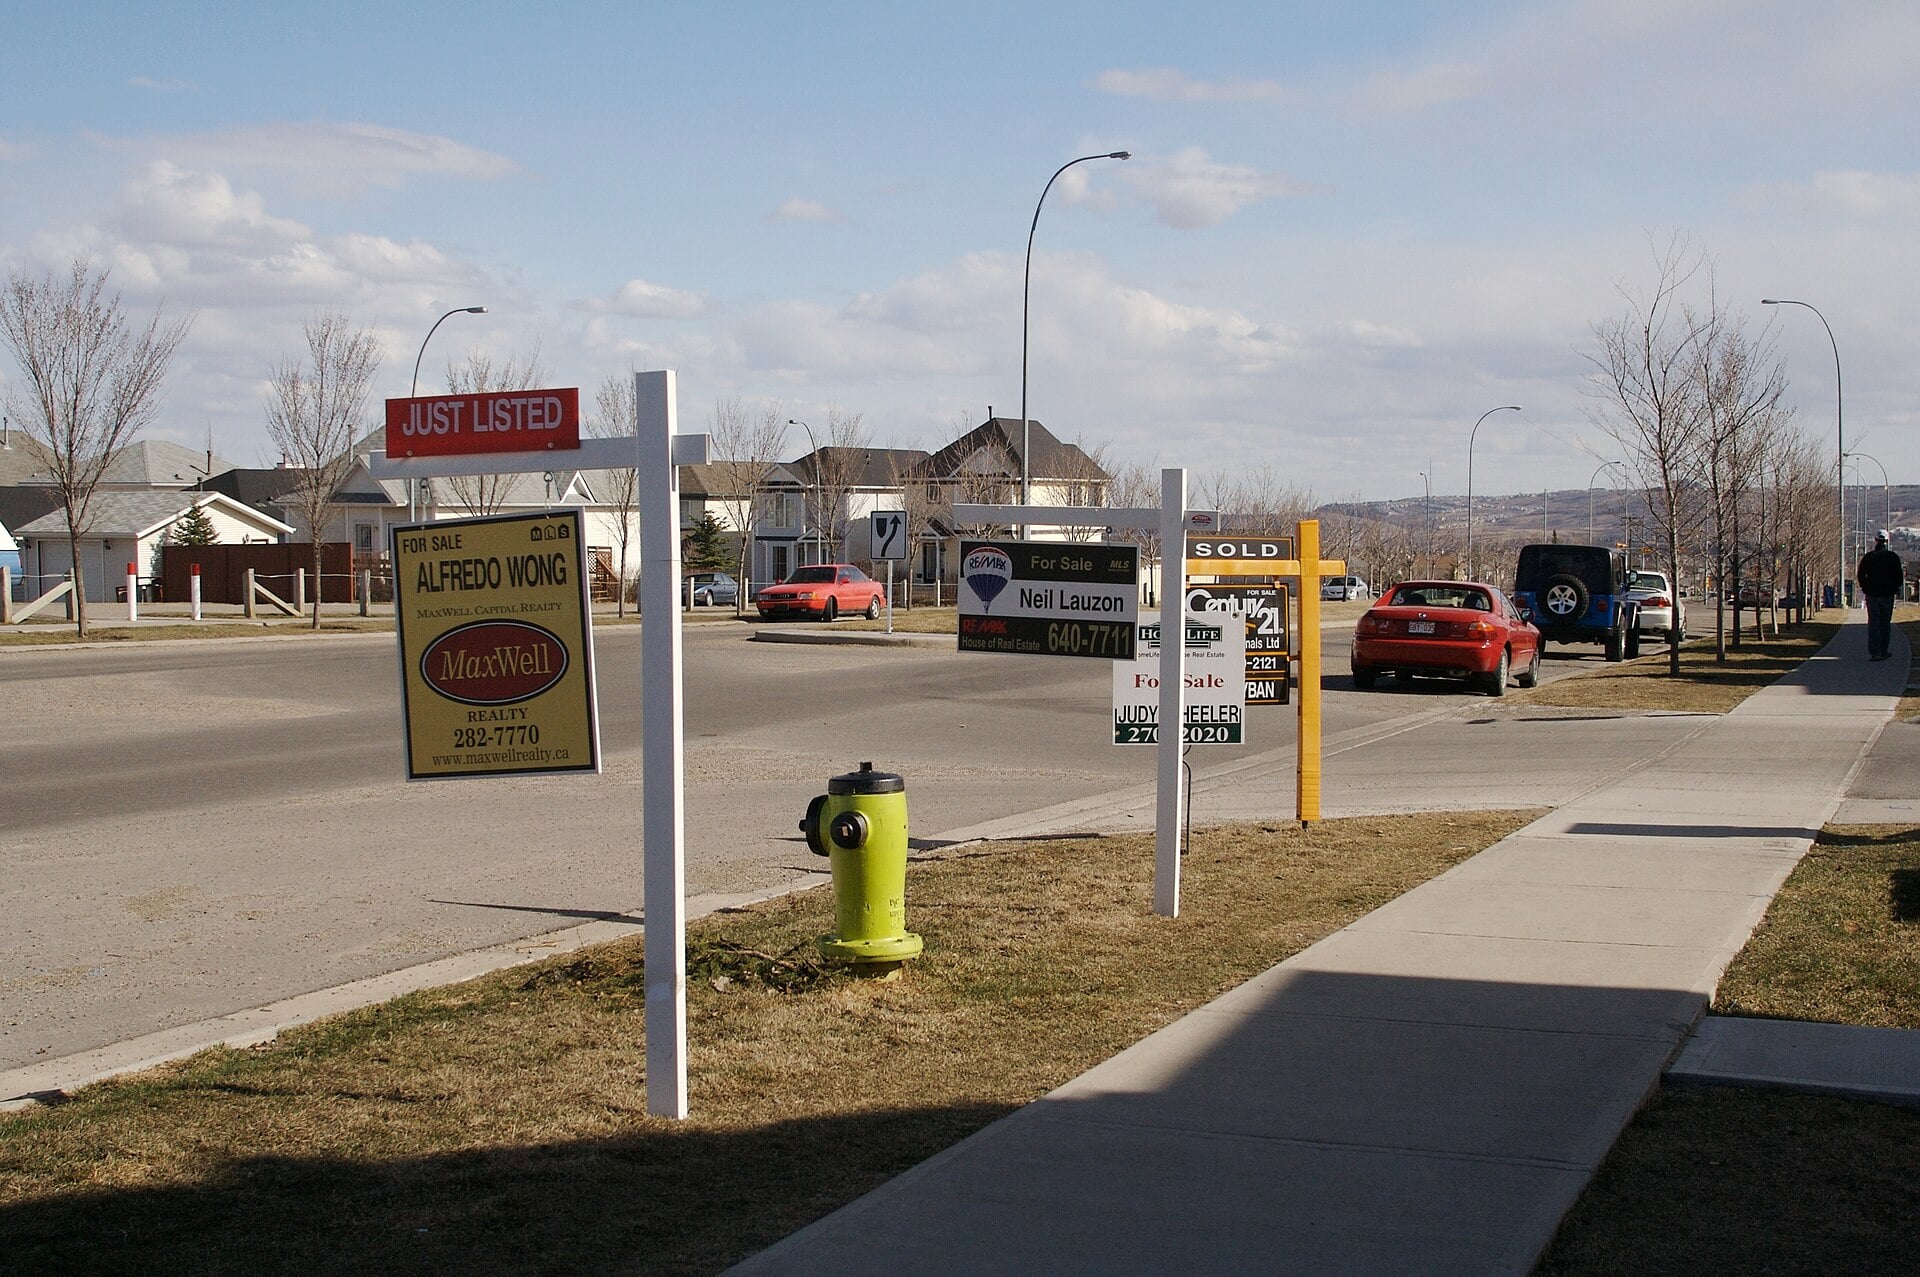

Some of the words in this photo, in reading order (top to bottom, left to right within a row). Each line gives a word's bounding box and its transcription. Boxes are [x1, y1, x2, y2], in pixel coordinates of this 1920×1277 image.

[402, 401, 465, 437] JUST
[473, 396, 563, 433] LISTED
[403, 537, 427, 554] FOR
[432, 534, 462, 551] SALE
[1195, 543, 1278, 557] SOLD
[969, 555, 1007, 571] RE/MAX
[1031, 556, 1056, 570] For
[1060, 556, 1093, 571] Sale
[1110, 560, 1130, 569] MLS
[417, 557, 501, 593] ALFREDO
[506, 552, 567, 588] WONG
[475, 604, 518, 615] CAPITAL
[520, 602, 562, 613] REALTY
[1020, 588, 1053, 609] Neil
[1060, 589, 1124, 613] Lauzon
[1185, 588, 1265, 618] Century
[1049, 622, 1130, 656] 640-7711
[1141, 628, 1219, 640] HOLIFE
[962, 636, 985, 648] House
[988, 637, 996, 648] of
[998, 637, 1014, 649] Real
[1016, 638, 1040, 650] Estate
[1266, 637, 1279, 649] Ltd
[439, 643, 552, 681] MaxWell
[1245, 657, 1277, 669] -2121
[1134, 674, 1159, 688] Fo
[1184, 674, 1224, 688] Sale
[467, 707, 529, 723] REALTY
[1118, 705, 1158, 723] JUDY
[1183, 704, 1239, 723] HEELER
[454, 724, 540, 748] 282-7770
[432, 747, 570, 766] www.maxwellrealty.ca
